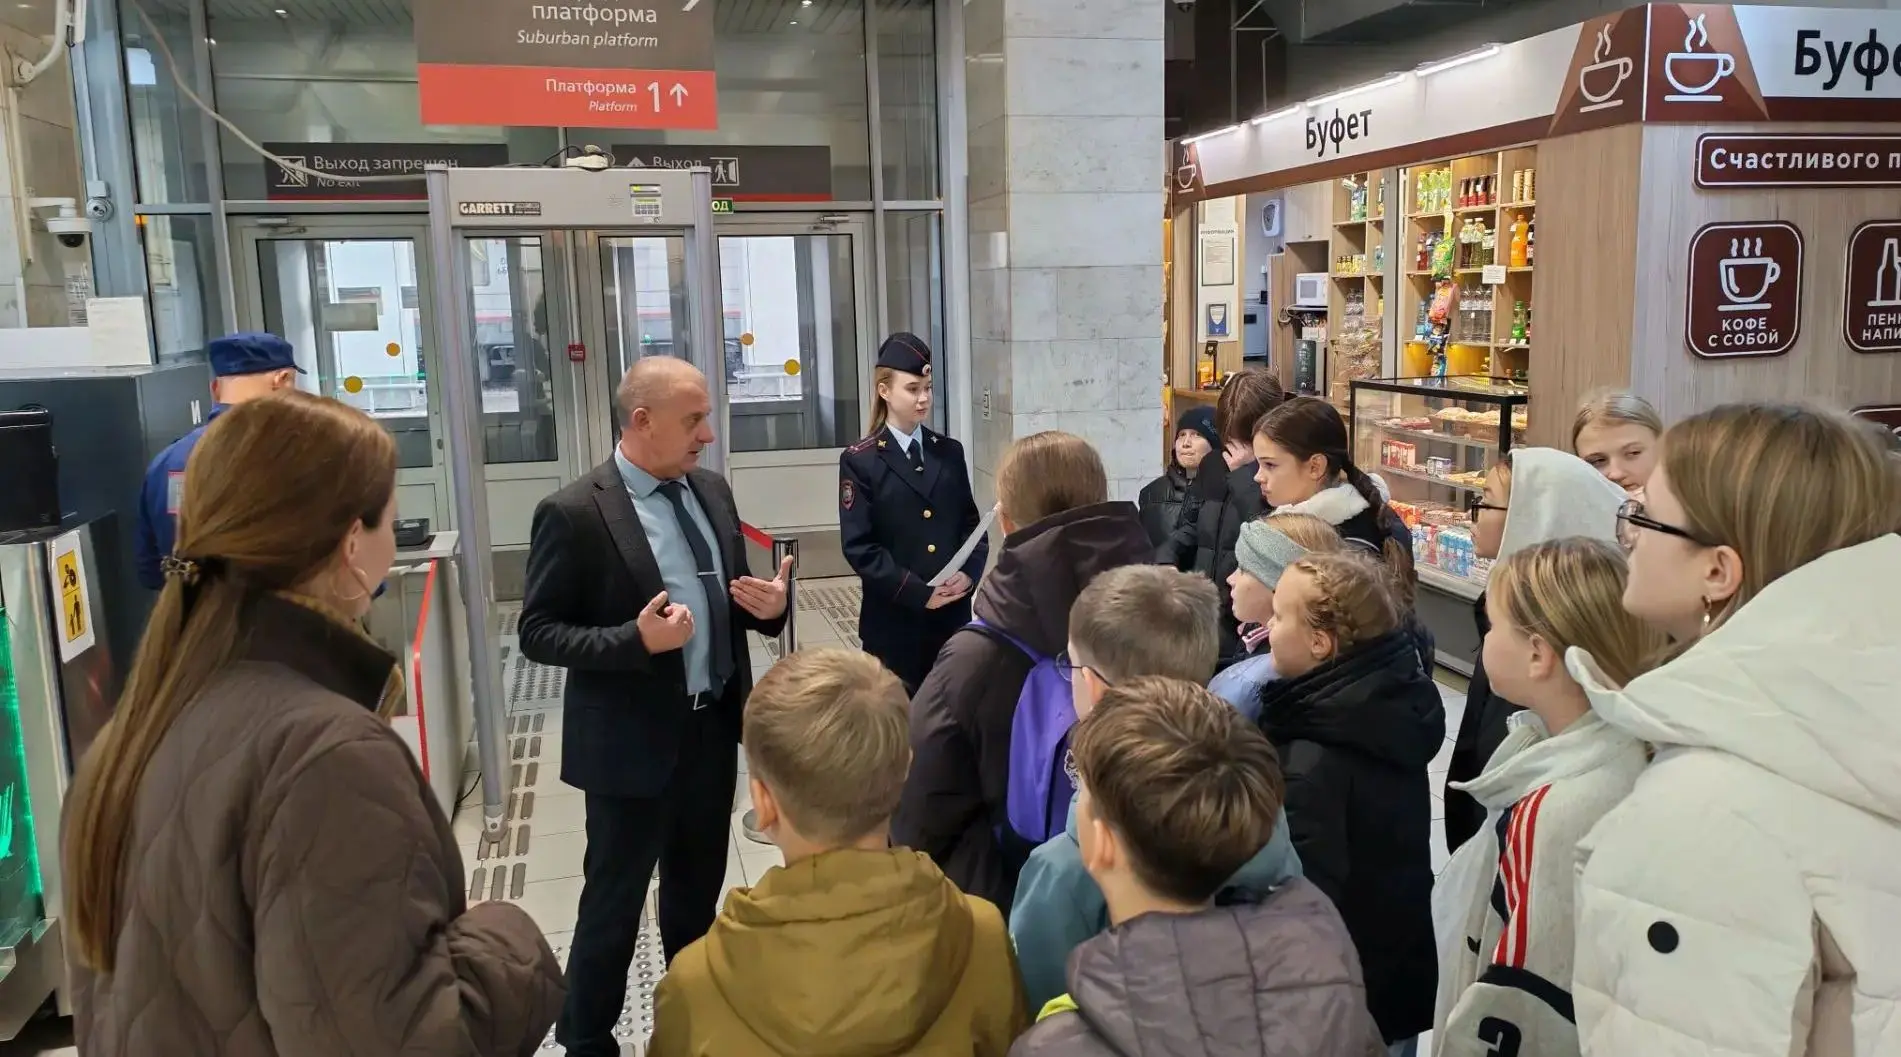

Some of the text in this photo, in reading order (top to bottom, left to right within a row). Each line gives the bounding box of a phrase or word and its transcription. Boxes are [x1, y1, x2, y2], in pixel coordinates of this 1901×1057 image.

[532, 4, 657, 27] платформа
[517, 29, 658, 49] Suburban platform
[1794, 29, 1901, 91] Буф
[545, 78, 660, 112] Платформа 1
[588, 100, 637, 112] Platform
[1306, 108, 1372, 157] Буфет
[314, 155, 370, 173] Выход
[1710, 148, 1880, 170] Счастливого
[460, 203, 515, 214] GARRETT
[1722, 317, 1767, 331] КОФЕ
[1708, 328, 1778, 347] С СОБОЙ
